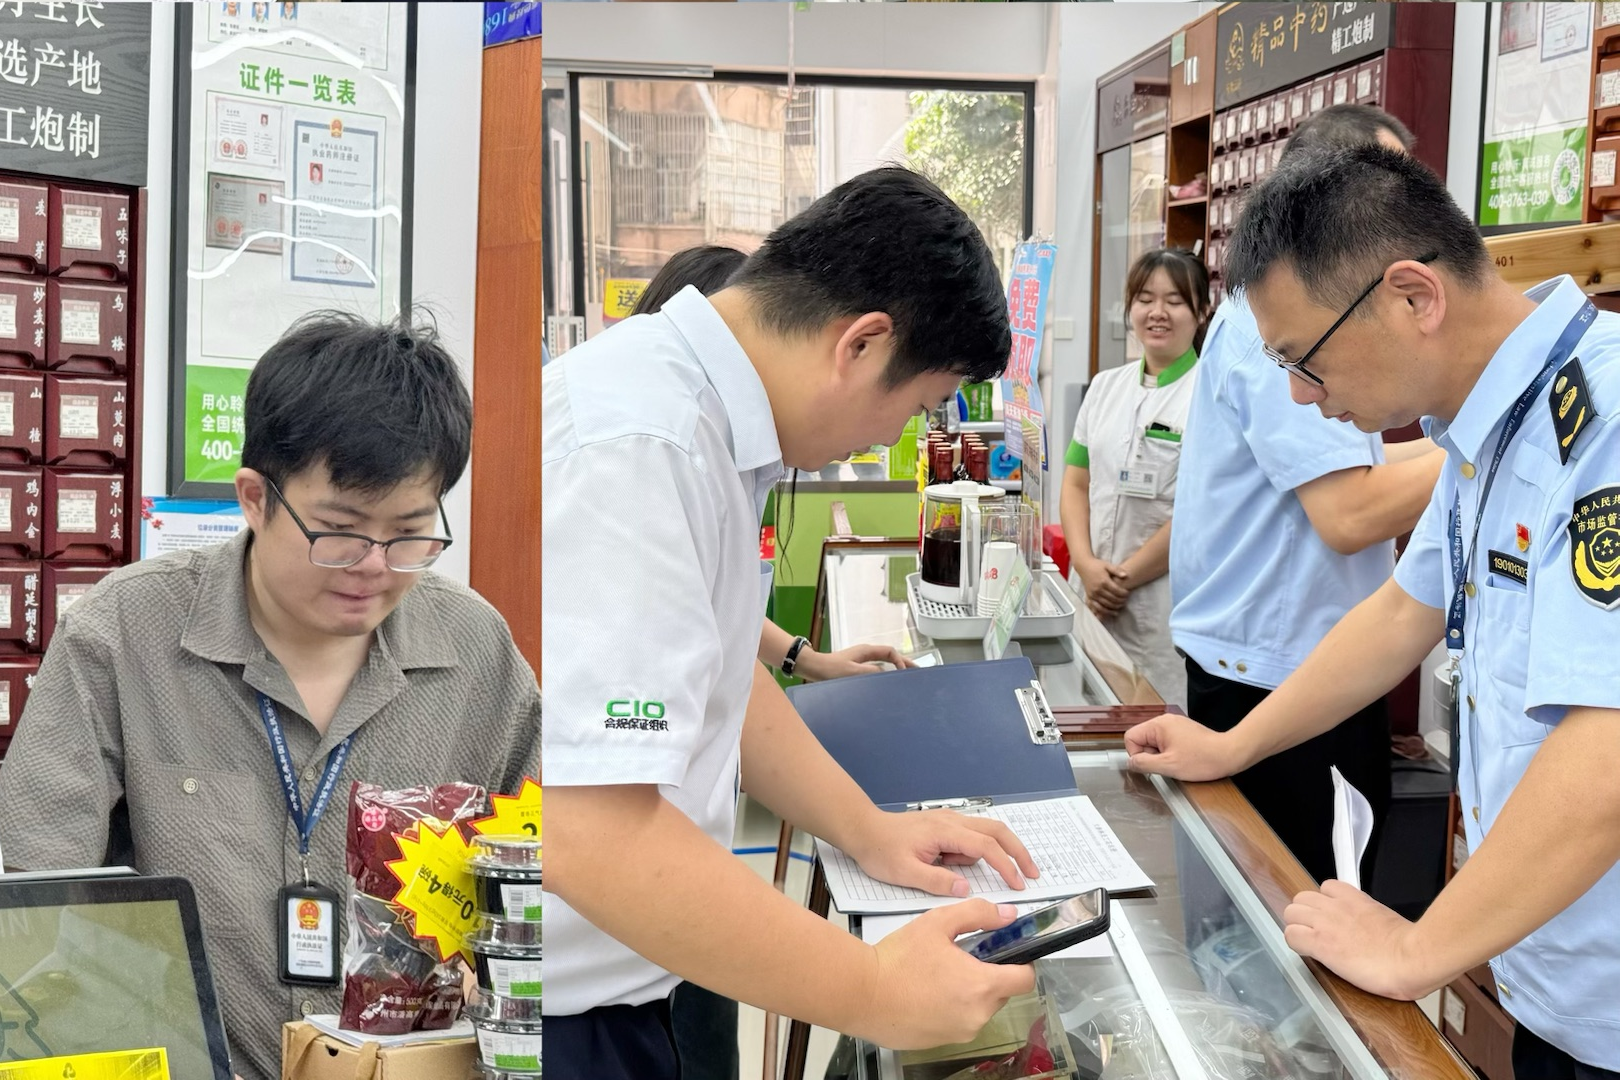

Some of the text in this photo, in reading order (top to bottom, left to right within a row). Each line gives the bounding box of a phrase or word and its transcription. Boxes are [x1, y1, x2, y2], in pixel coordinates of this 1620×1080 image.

[1329, 11, 1376, 56] 精工炮制
[239, 62, 357, 107] 证件一览表
[1487, 190, 1549, 209] 400-8763-030
[34, 198, 47, 260] 麦芽
[115, 207, 129, 265] 五味子
[33, 286, 46, 348] 炒麦芽
[111, 293, 126, 353] 乌梅
[616, 288, 638, 308] 送
[24, 478, 40, 540] 鸡内金
[109, 481, 123, 541] 浮小麦
[604, 717, 669, 732] 合规保证组织
[605, 699, 666, 719] CIO
